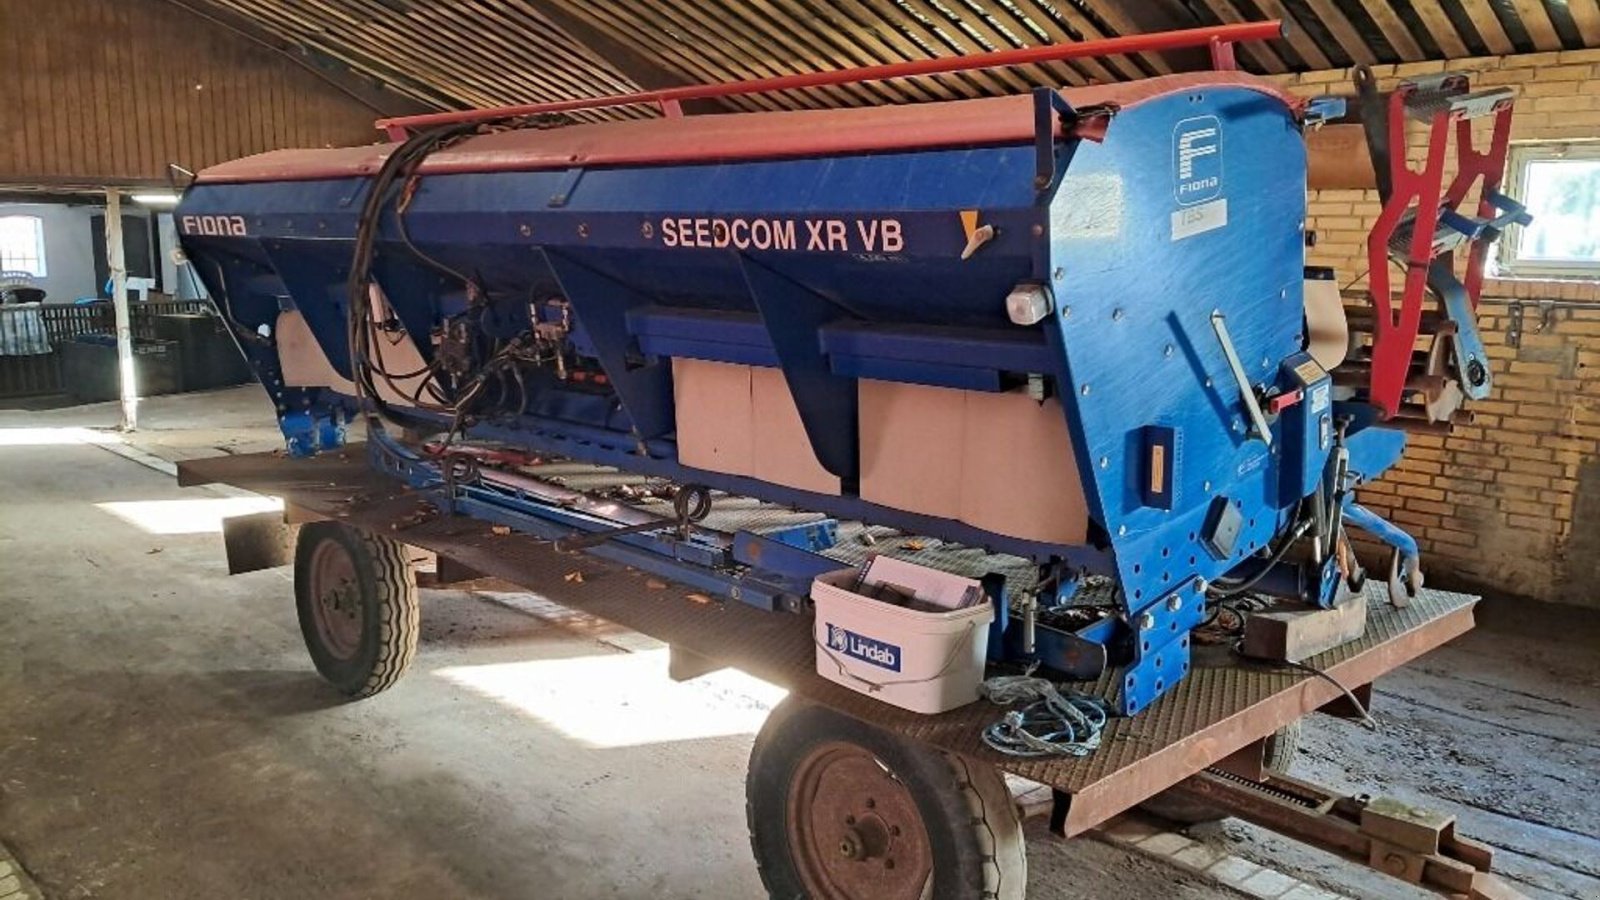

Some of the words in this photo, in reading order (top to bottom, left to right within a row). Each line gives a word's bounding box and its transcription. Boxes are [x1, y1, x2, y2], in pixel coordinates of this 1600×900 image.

[662, 218, 797, 250] SEEDCOM
[805, 220, 848, 251] XR
[857, 219, 903, 252] VB
[851, 636, 895, 665] Lindab
